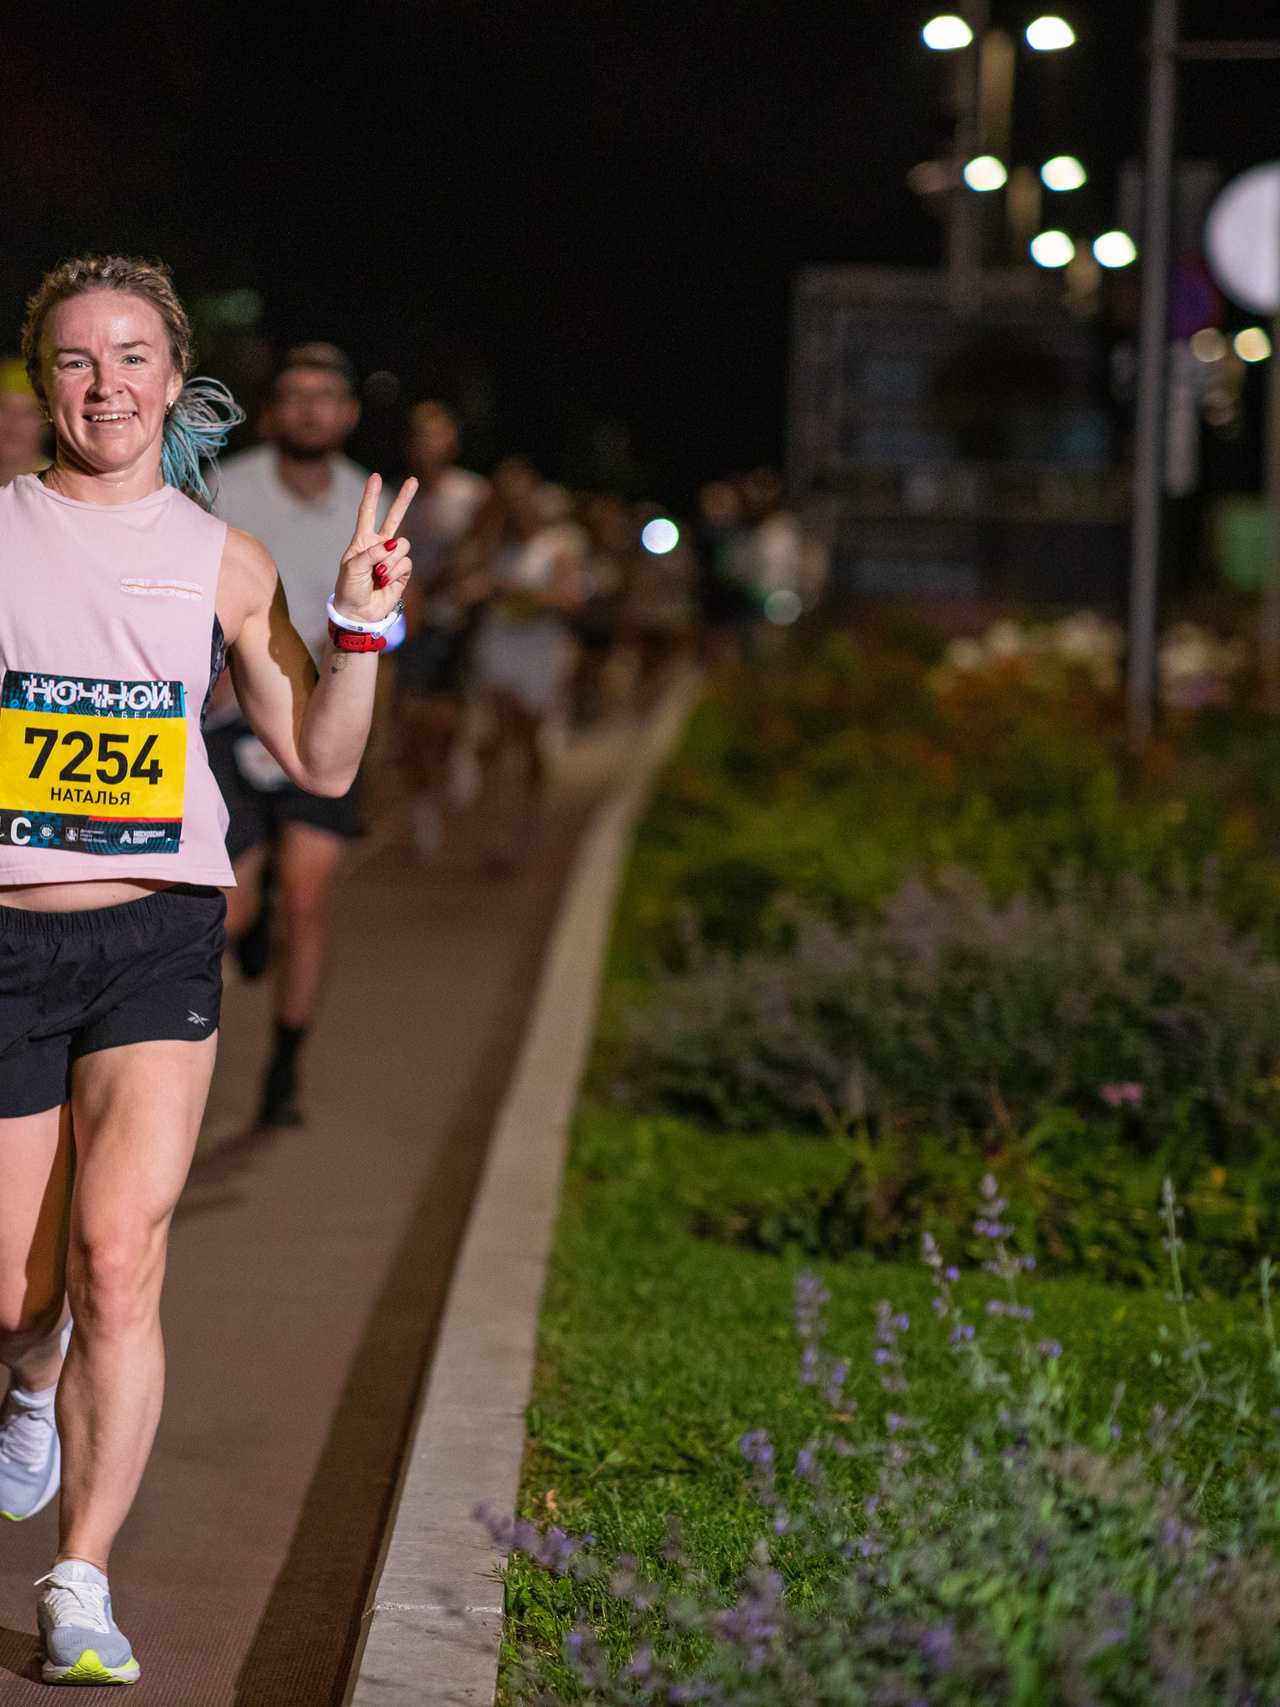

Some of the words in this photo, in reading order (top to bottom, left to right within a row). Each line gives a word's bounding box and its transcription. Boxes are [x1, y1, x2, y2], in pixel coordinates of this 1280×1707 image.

[22, 674, 174, 711] НОЧНОЙ
[24, 727, 163, 785] 7254
[50, 787, 130, 805] НАТАЛЬЯ
